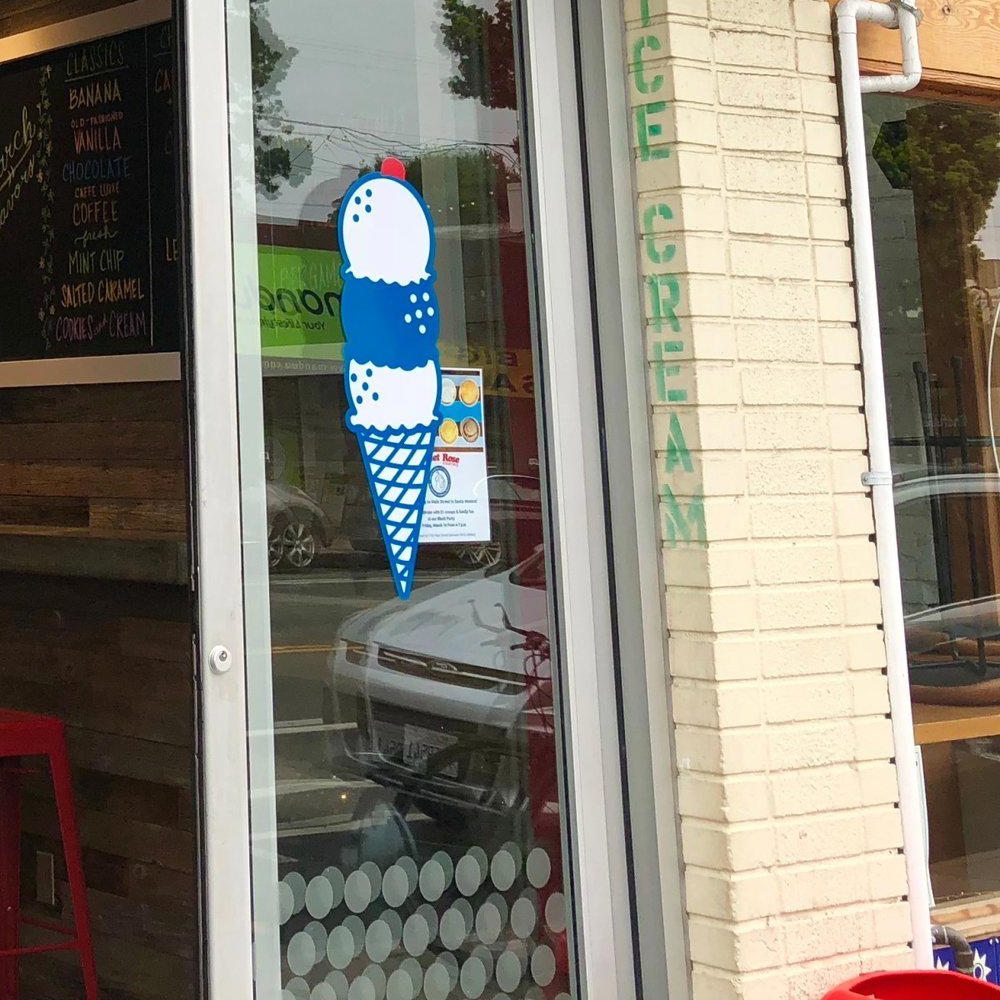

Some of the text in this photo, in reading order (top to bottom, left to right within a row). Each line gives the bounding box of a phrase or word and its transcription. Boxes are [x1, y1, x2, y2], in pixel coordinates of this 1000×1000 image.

[68, 78, 122, 110] BANANA
[73, 126, 122, 155] VANILLA
[62, 155, 133, 184] CHOCOLATE
[72, 200, 119, 226] COFFEE
[68, 248, 125, 275] MINT CHIP
[61, 277, 145, 308] SALTED CARAMEL
[55, 316, 94, 342] COOKIES
[109, 310, 149, 340] CREAM
[644, 202, 707, 550] CREAM
